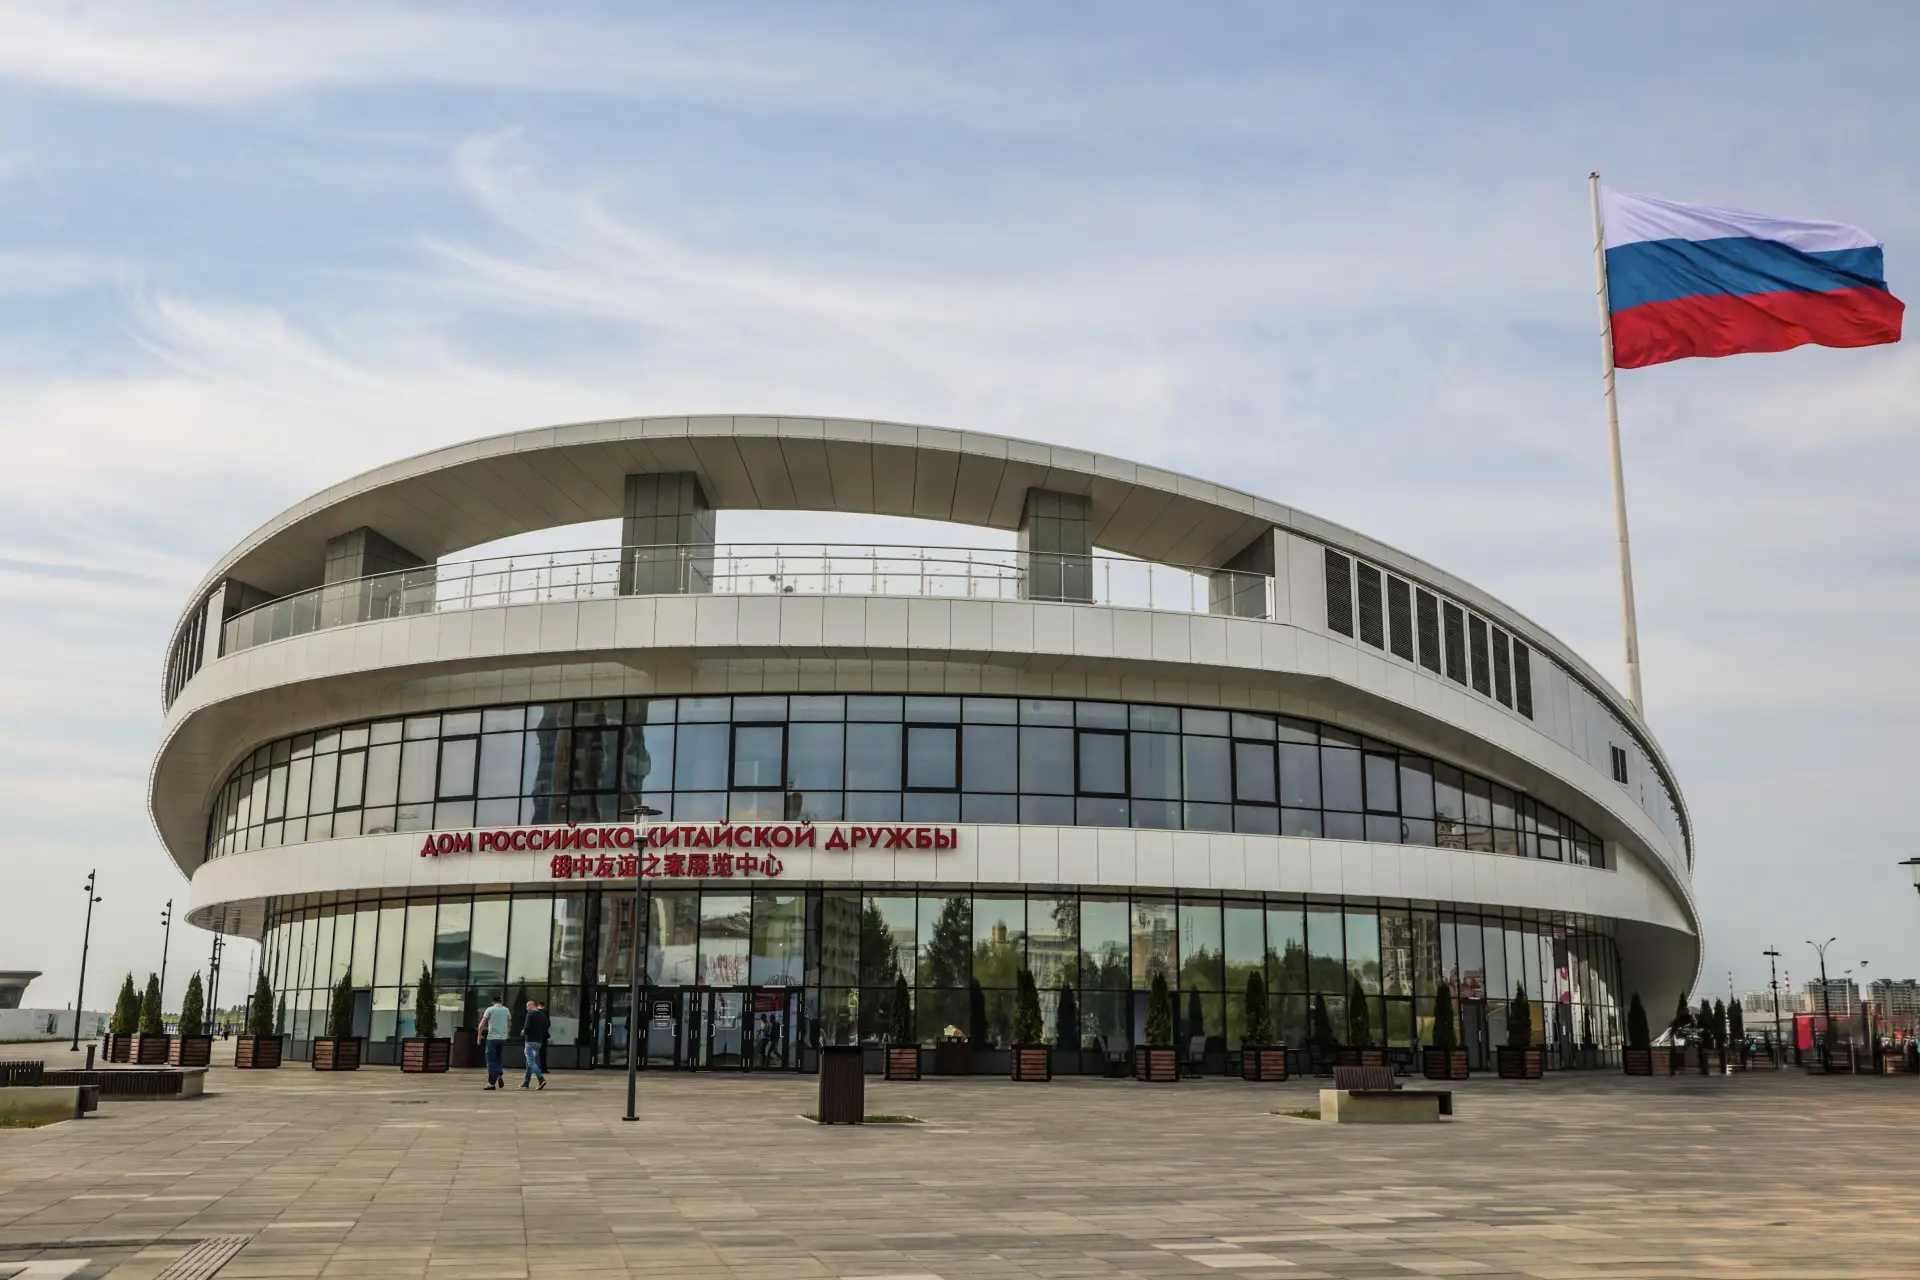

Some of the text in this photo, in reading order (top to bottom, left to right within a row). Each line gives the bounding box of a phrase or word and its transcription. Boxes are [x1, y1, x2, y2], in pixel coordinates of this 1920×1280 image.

[421, 820, 957, 857] ДОМ РОССИЙСКОКИТАЙСКОЙ ДРУЖБЫ
[551, 852, 783, 879] 俄中友谊之家展览中心
